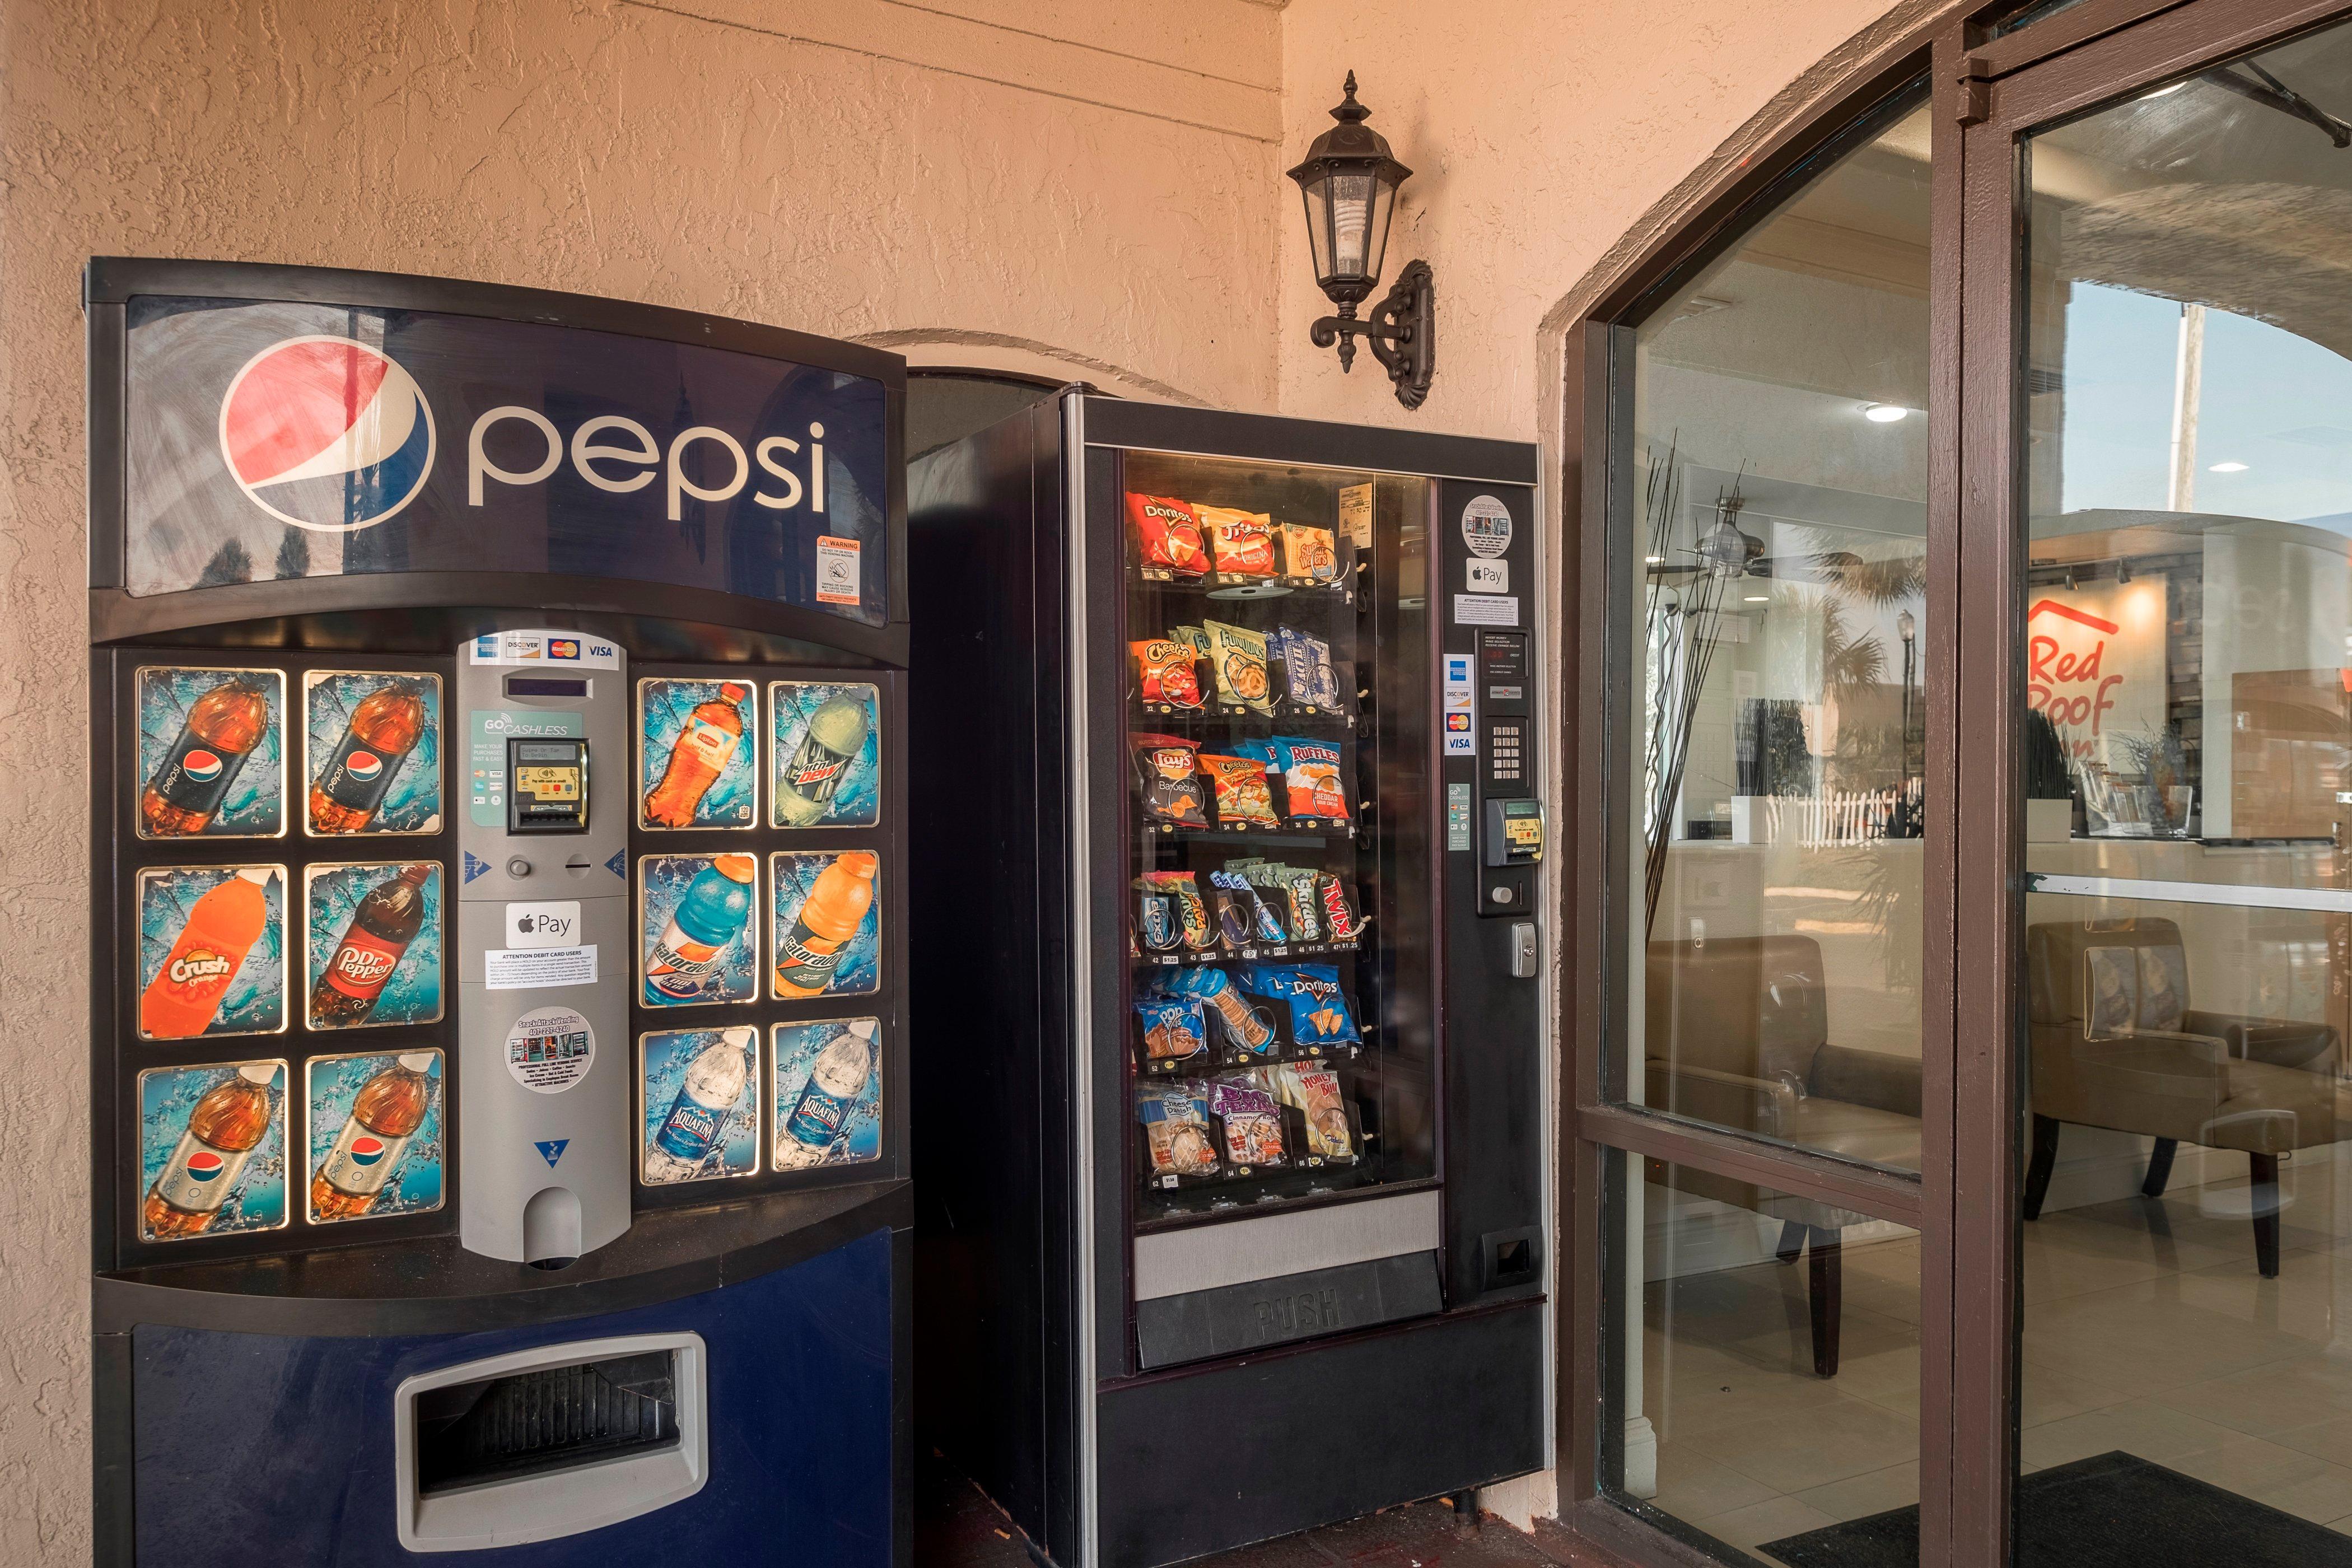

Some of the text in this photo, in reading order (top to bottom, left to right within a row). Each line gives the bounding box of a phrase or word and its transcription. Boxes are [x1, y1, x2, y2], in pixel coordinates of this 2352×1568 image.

[468, 405, 824, 521] pepsi
[1145, 506, 1192, 523] Doritos
[1219, 520, 1270, 540] Fritos
[830, 540, 857, 549] WARNING
[1301, 542, 1326, 557] Sugar
[1299, 554, 1328, 570] Wafers
[1483, 567, 1502, 585] Pay
[589, 645, 613, 657] VISA
[1147, 643, 1191, 661] Cheetos
[1221, 630, 1264, 660] FUNYUNS
[2030, 635, 2104, 684] Red
[1295, 659, 1306, 682] ACT
[485, 719, 567, 735] GO CASHLESS
[698, 734, 718, 747] Lipton
[1449, 739, 1470, 748] VISA
[1158, 753, 1191, 769] Lay's
[1291, 747, 1340, 763] RUFFLES
[1220, 761, 1250, 773] Cheetos
[162, 763, 181, 794] pepsi
[328, 764, 345, 794] pepsi
[1159, 781, 1196, 793] Barbecue
[1323, 878, 1351, 937] TWIX
[539, 915, 571, 937] Pay
[338, 947, 393, 979] Pepper
[357, 951, 384, 966] Dr
[170, 955, 230, 982] Crush
[189, 975, 218, 987] Orange
[1294, 981, 1337, 995] Doritos
[519, 1020, 536, 1028] Snack
[557, 1016, 579, 1024] Vending
[529, 1025, 570, 1035] 407-227-4240
[1301, 1074, 1331, 1090] HONEY
[1320, 1082, 1337, 1098] BUN
[1219, 1086, 1272, 1103] BIG
[1161, 1099, 1192, 1108] Cheese
[1216, 1100, 1280, 1116] TEXAS
[799, 1095, 841, 1129] AQUAFINA
[669, 1106, 714, 1141] AQUAFINA
[801, 1120, 810, 1128] Water
[331, 1151, 347, 1180] pepsi
[166, 1166, 184, 1197] pepsi
[1254, 1289, 1341, 1340] PUSH
